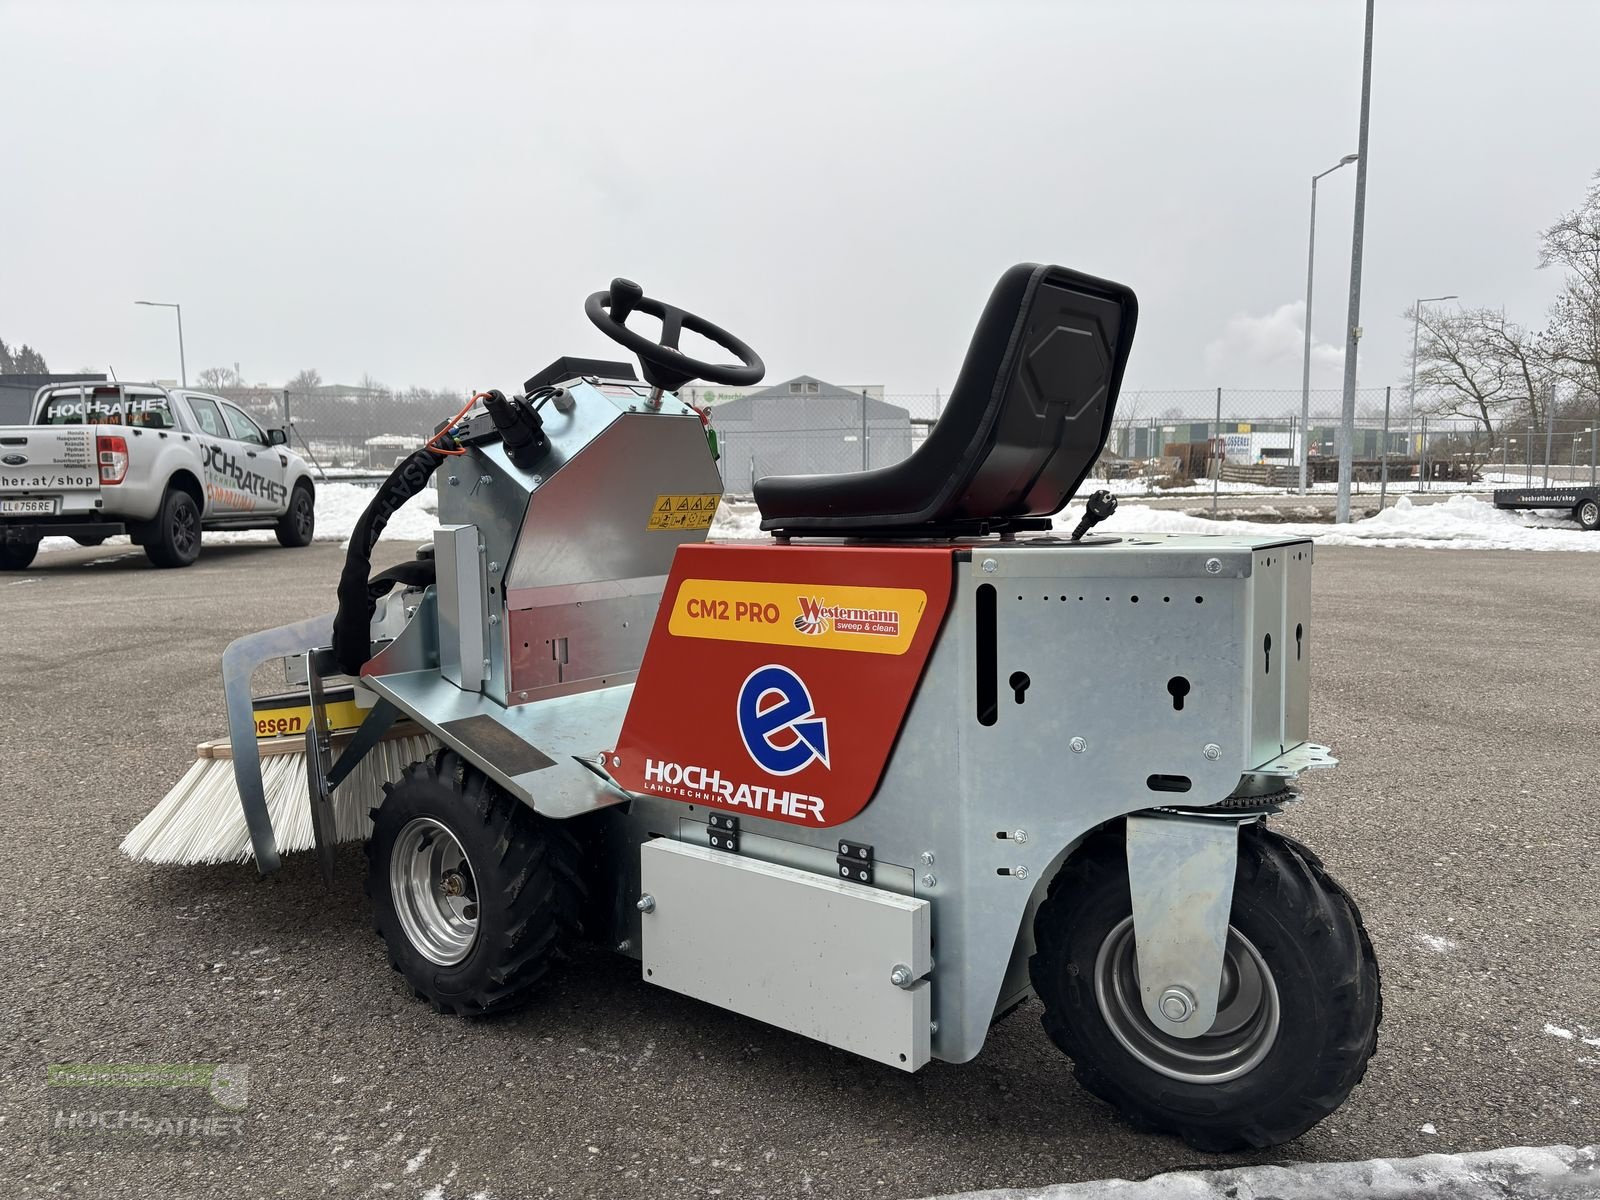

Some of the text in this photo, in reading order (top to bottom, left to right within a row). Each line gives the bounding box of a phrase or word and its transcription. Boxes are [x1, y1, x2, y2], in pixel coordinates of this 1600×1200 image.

[2, 475, 93, 488] her.at/shop
[686, 598, 780, 624] CM2 PRO
[798, 596, 899, 622] Westermann
[837, 623, 863, 632] sweep
[864, 623, 870, 631] &
[644, 758, 826, 823] HOCHRATHER
[644, 782, 723, 803] LANDTECHNIK
